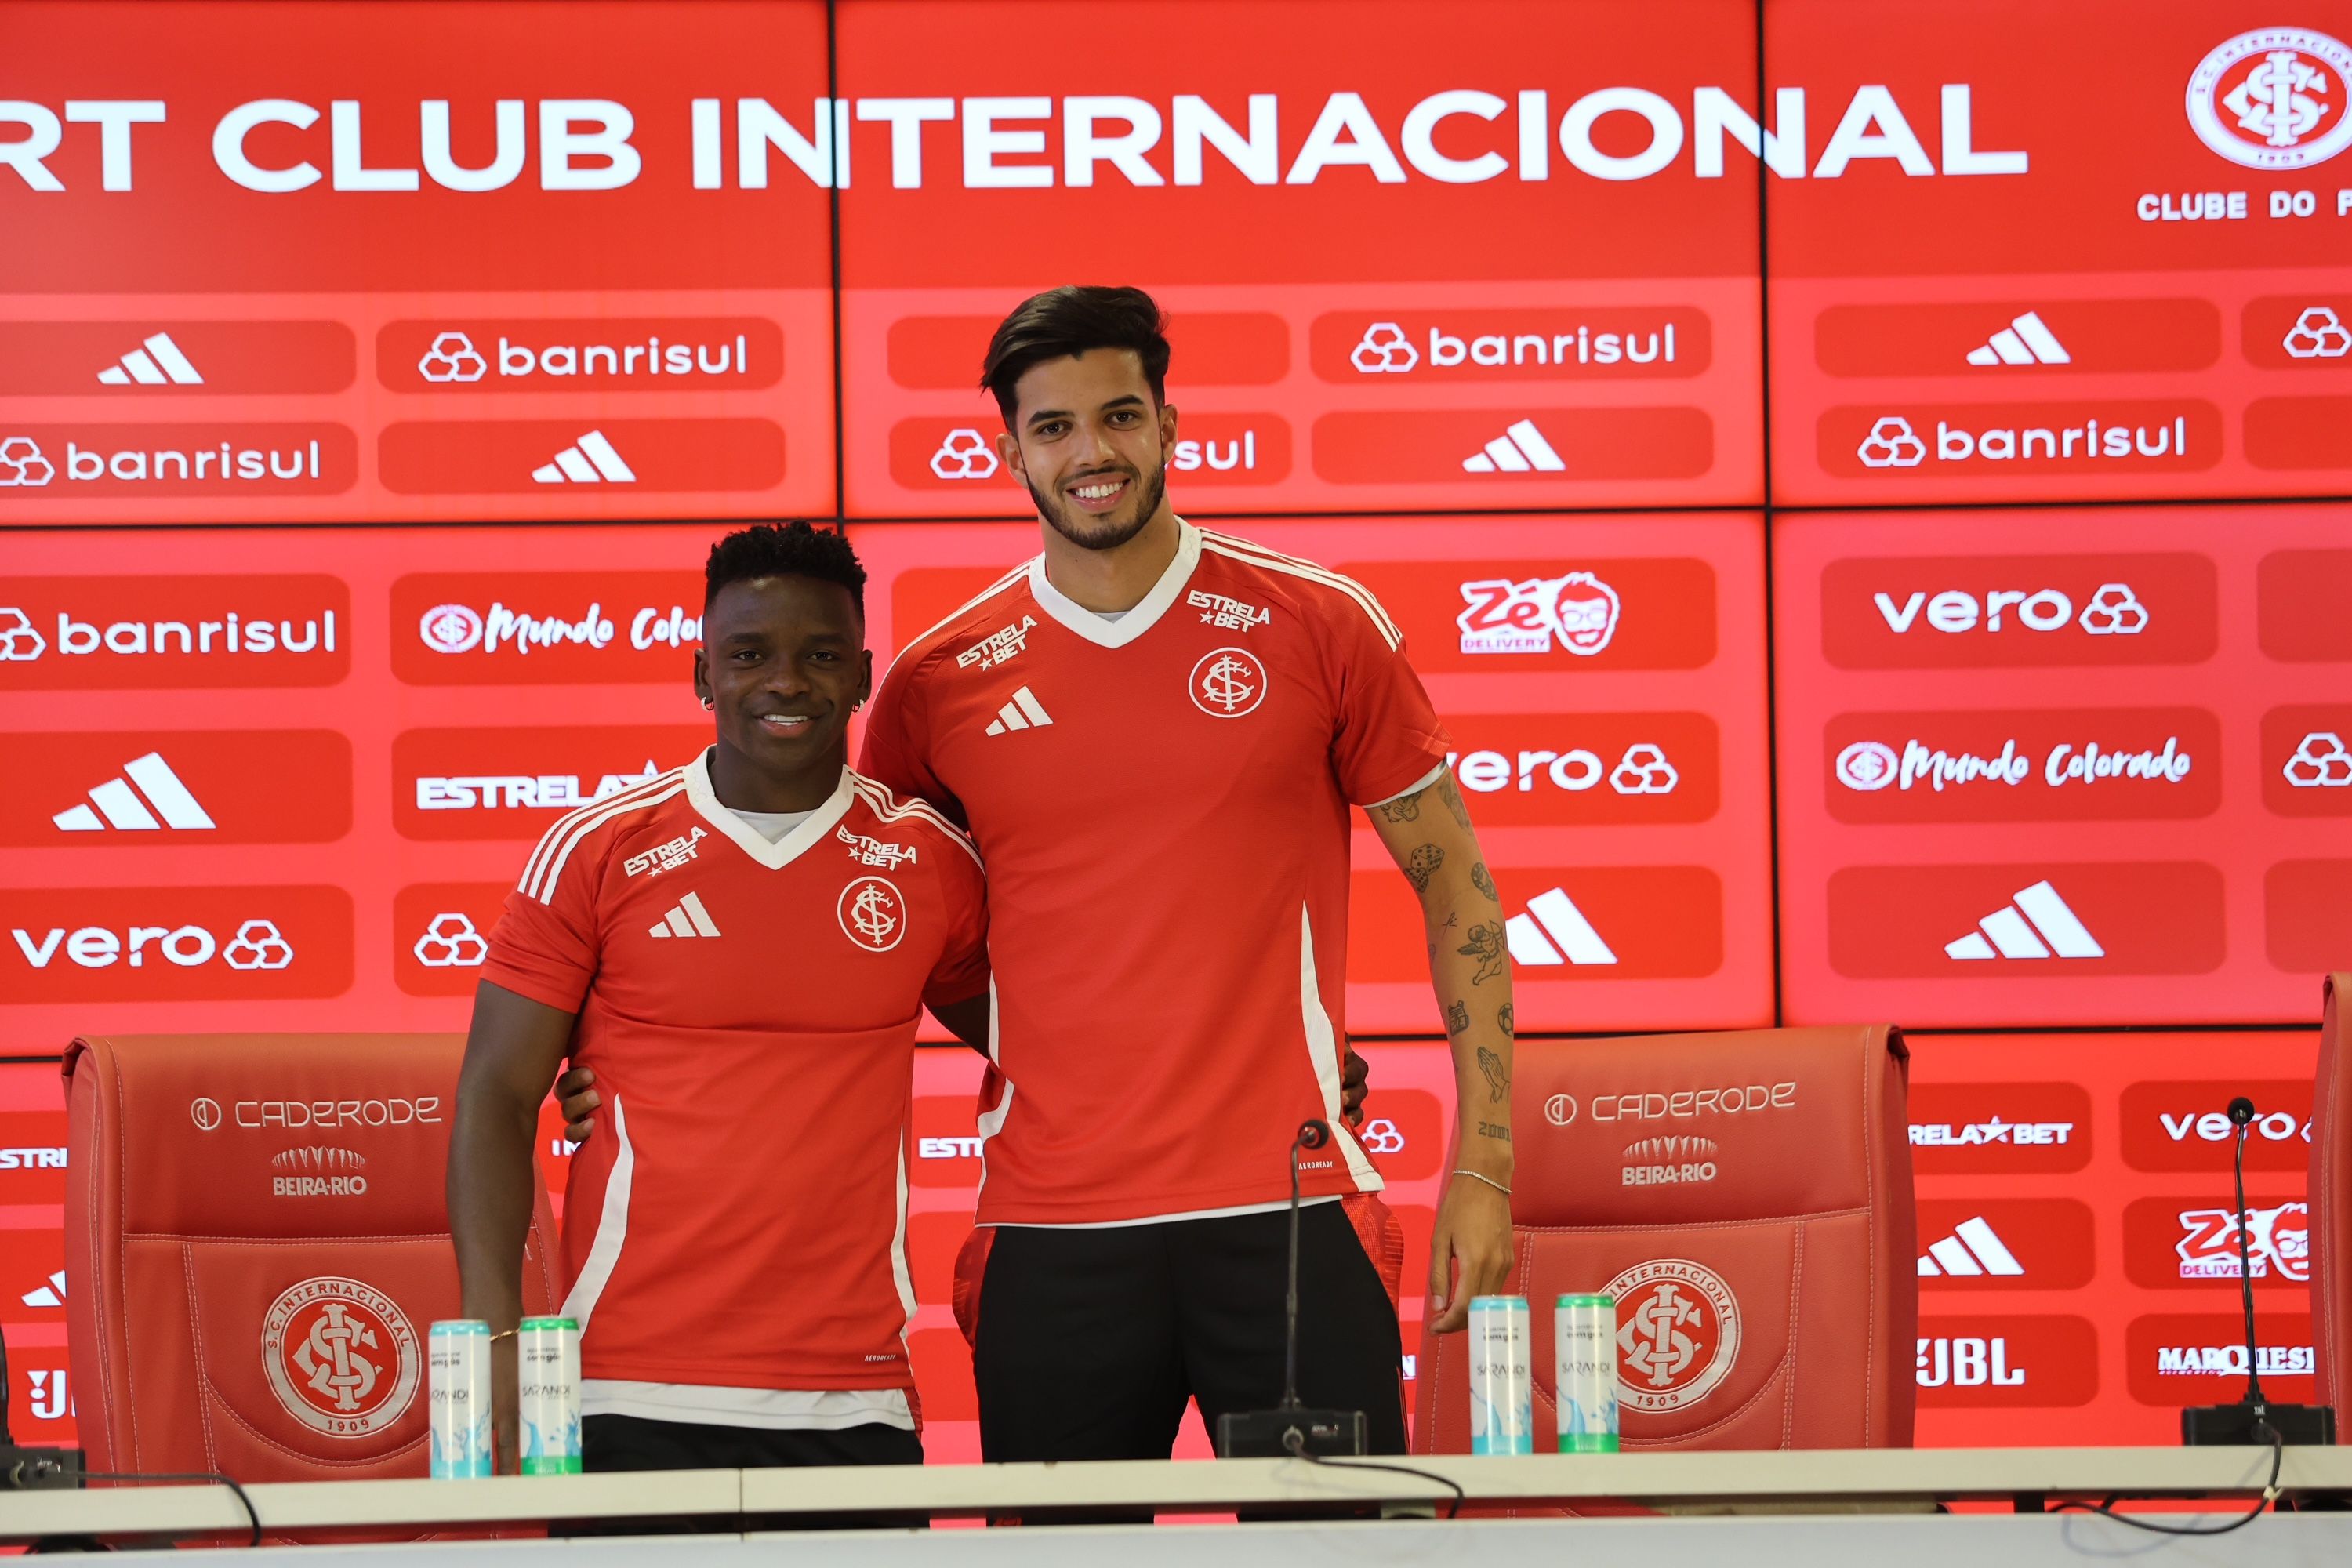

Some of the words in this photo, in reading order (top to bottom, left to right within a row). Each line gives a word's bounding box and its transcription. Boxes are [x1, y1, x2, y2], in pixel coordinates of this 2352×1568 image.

[212, 98, 641, 193] CLUB
[691, 83, 2028, 191] INTERNACIONAL
[2137, 191, 2248, 221] CLUBE
[2270, 189, 2317, 219] DO
[499, 335, 746, 376] banrisul
[1429, 322, 1675, 367] banrisul
[1937, 417, 2185, 461] banrisul
[67, 440, 319, 481] banrisul
[1186, 589, 1270, 625] ESTRELA
[1214, 613, 1255, 633] BET
[1459, 581, 1549, 633] Zé
[1874, 589, 2072, 633] vero
[58, 610, 336, 655] banrisul
[485, 602, 614, 655] Mundo
[956, 615, 1038, 670] ESTRELA
[1463, 637, 1547, 649] DELIVERY
[991, 633, 1027, 666] BET
[1900, 739, 2029, 792] Mundo
[2045, 736, 2191, 786] Colorado
[623, 826, 709, 877] ESTRELA
[664, 844, 702, 872] BET
[836, 824, 917, 865] ESTRELA
[860, 849, 903, 872] BET
[12, 925, 216, 967] vero
[235, 1097, 442, 1128] CADERODE
[1591, 1081, 1796, 1121] CADERODE
[2013, 1123, 2074, 1145] BET
[273, 1176, 367, 1196] BEIRA-RIO
[1298, 1160, 1334, 1171] AEROREADY
[1621, 1161, 1718, 1186] BEIRA-RIO
[2182, 1264, 2265, 1276] DELIVEY
[278, 1282, 411, 1349] INTERNACIONAL
[1610, 1265, 1733, 1325] INTERNACIONAL
[1916, 1338, 2025, 1387] JBL
[1636, 1395, 1679, 1407] 1909
[327, 1418, 370, 1432] 1909
